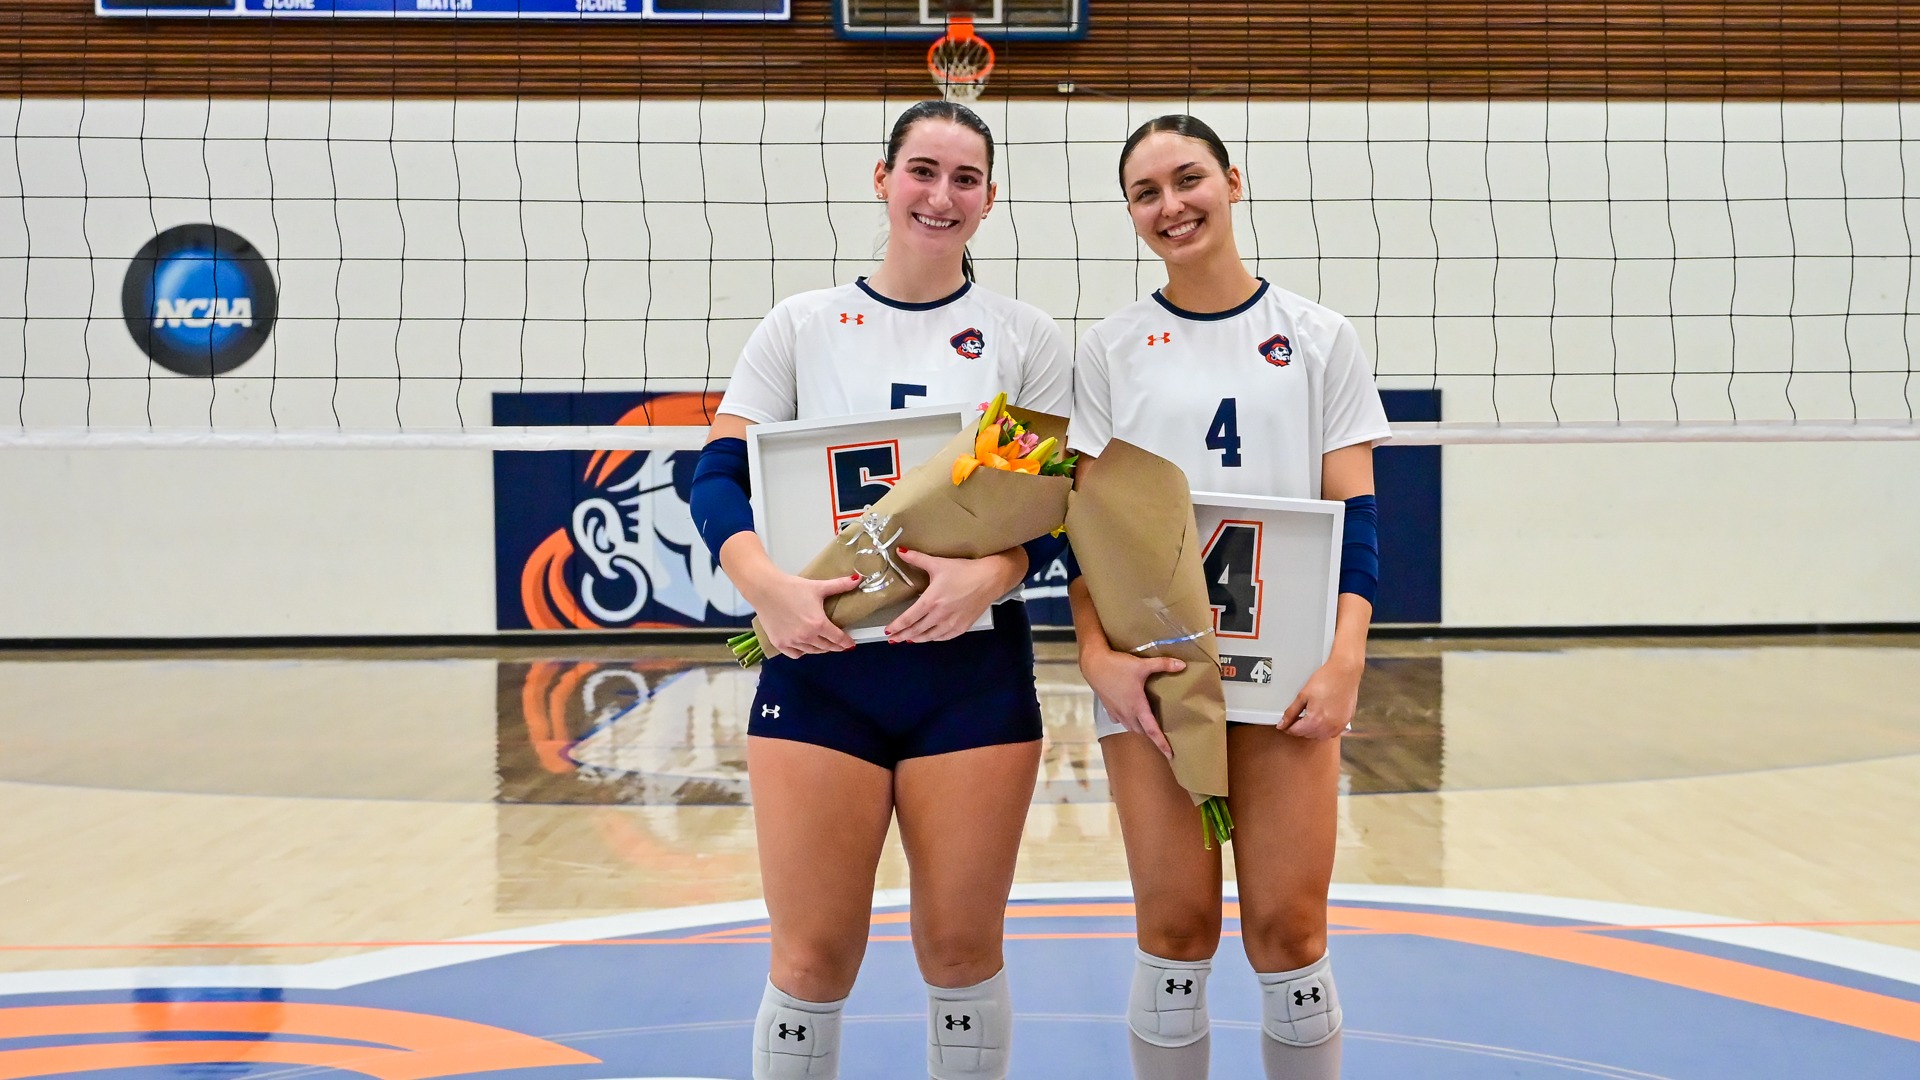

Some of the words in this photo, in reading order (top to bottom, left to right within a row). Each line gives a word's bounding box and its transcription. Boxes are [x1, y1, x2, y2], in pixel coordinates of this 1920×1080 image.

[153, 298, 253, 328] NCAA
[1205, 397, 1241, 467] 4
[1201, 519, 1263, 639] 4
[1250, 660, 1265, 684] 4
